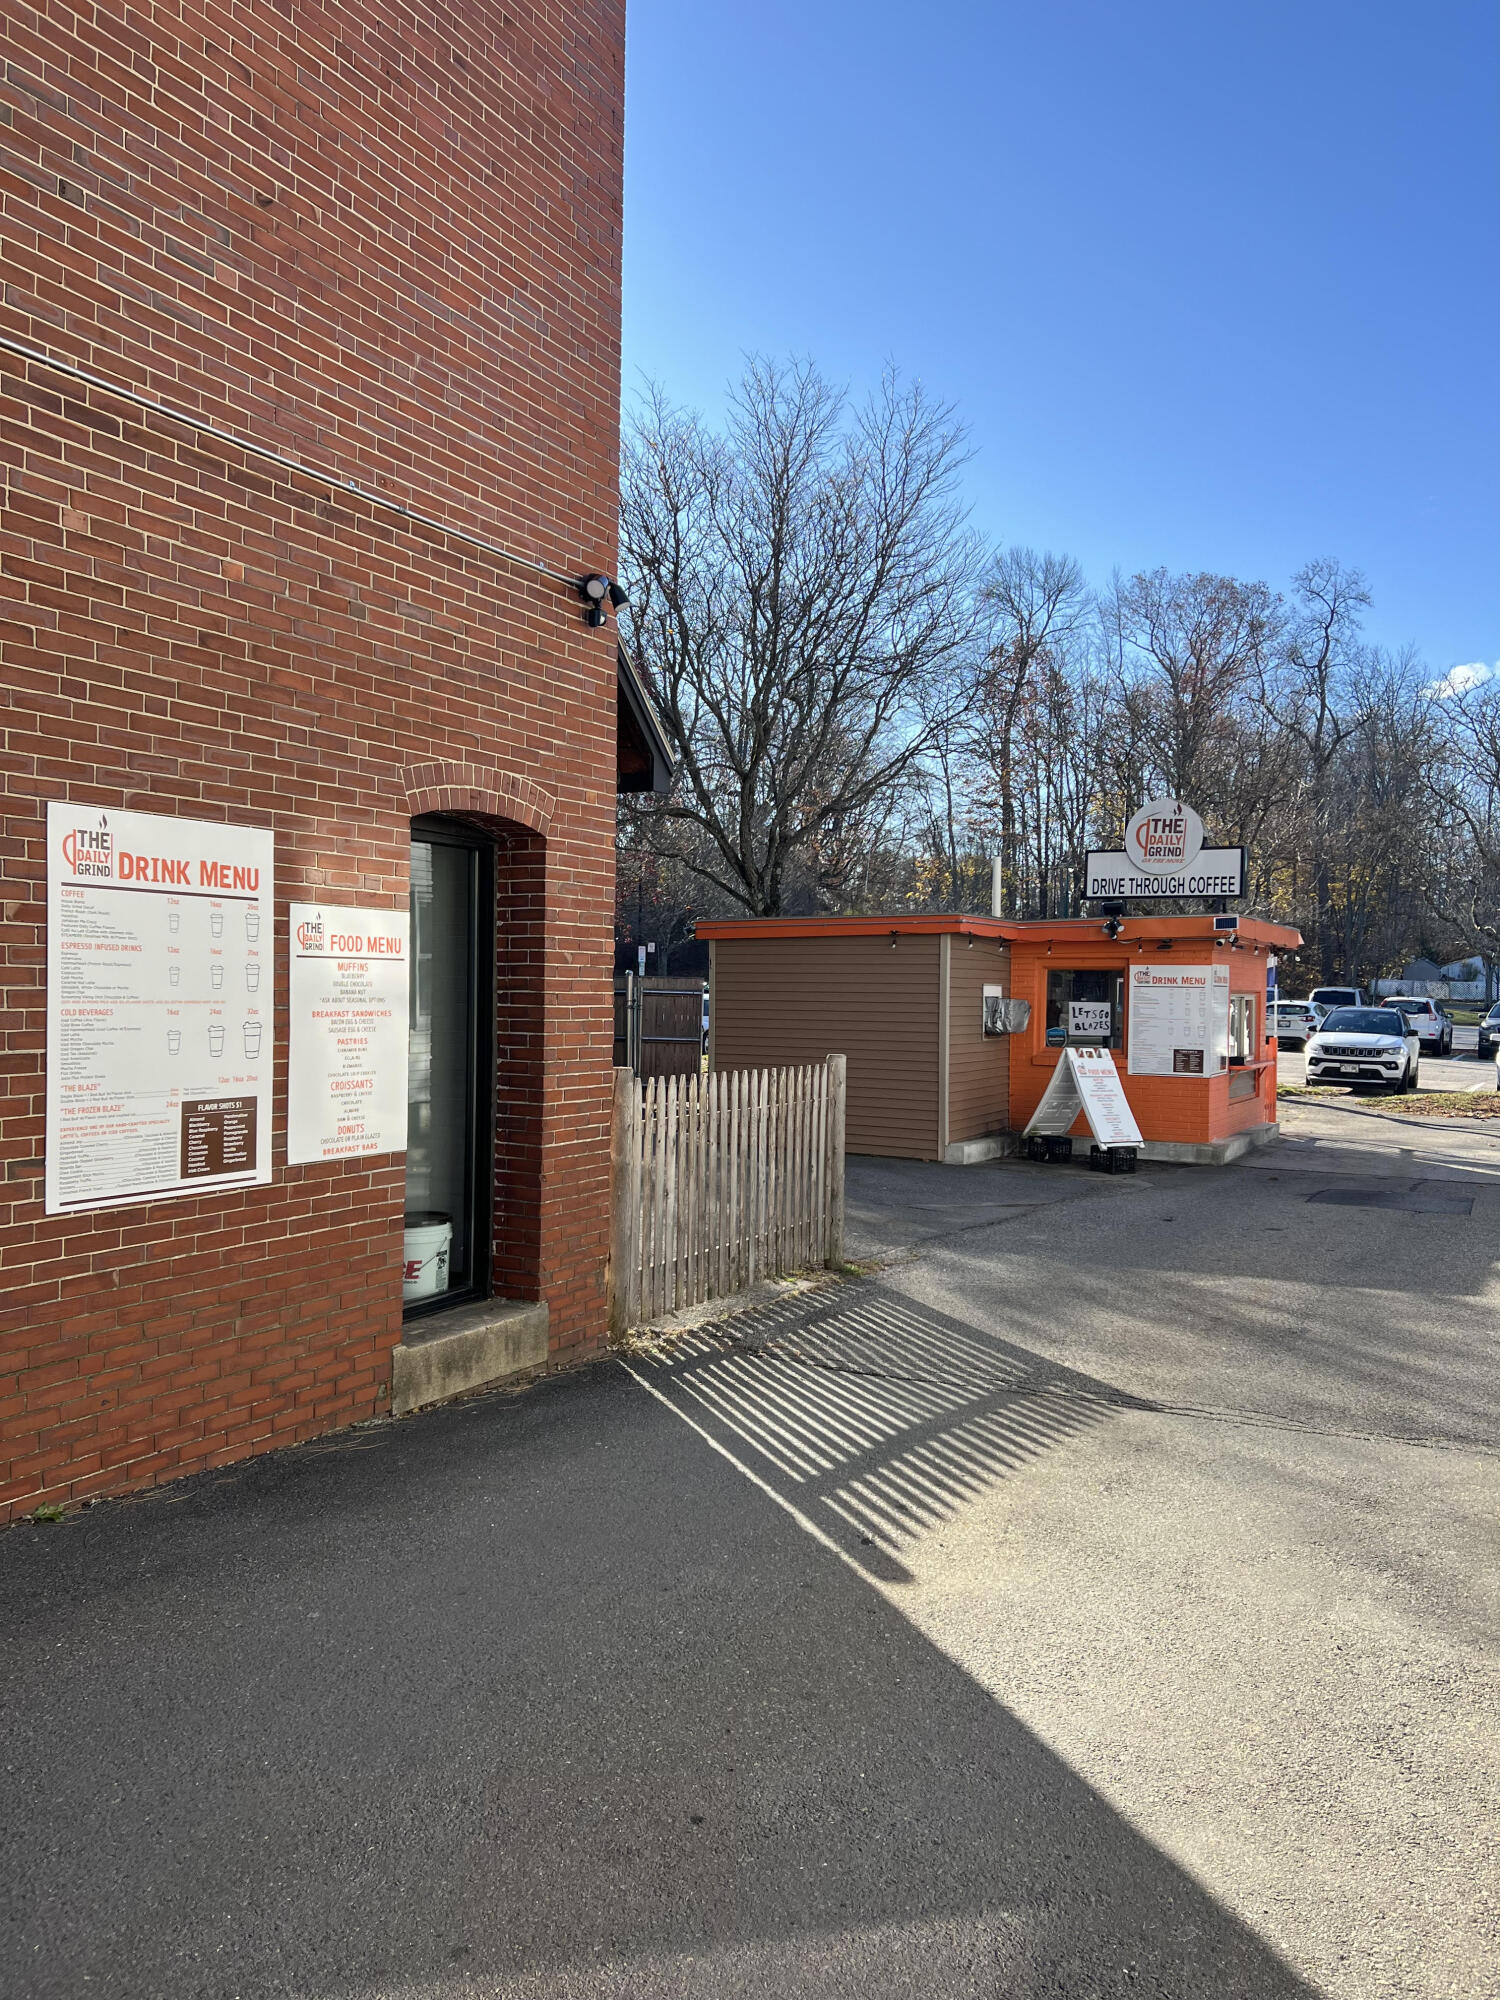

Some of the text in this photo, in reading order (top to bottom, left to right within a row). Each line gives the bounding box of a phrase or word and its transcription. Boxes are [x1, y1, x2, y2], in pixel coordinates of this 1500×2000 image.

[1152, 818, 1184, 834] THE
[77, 830, 110, 850] THE
[1150, 835, 1182, 845] DAILY
[77, 849, 110, 864] DAILY
[1148, 847, 1181, 857] GRIND
[77, 863, 110, 877] GRIND
[119, 852, 259, 891] DRINK MENU
[1092, 876, 1235, 895] DRIVE THROUGH COFFEE
[61, 890, 85, 898] COFFEE
[305, 922, 322, 934] THE
[305, 934, 322, 942] DAILY
[61, 942, 142, 952] ESPRESSO INFUSED DRINKS
[305, 942, 322, 951] GRIND
[331, 935, 401, 954] FOOD MENU
[338, 962, 368, 972] MUFFINS
[1152, 976, 1178, 985] DRINK
[1182, 976, 1206, 985] MENU
[1099, 1010, 1109, 1019] GO
[1075, 1021, 1110, 1031] BLAZES
[331, 1079, 373, 1091] CROISSANTS
[78, 1106, 101, 1114] FROZEN
[219, 1102, 235, 1110] SHOTS
[338, 1124, 365, 1135] DONUTS
[320, 1136, 344, 1144] CHOCOLATE
[323, 1142, 378, 1155] BREAKFAST BARS
